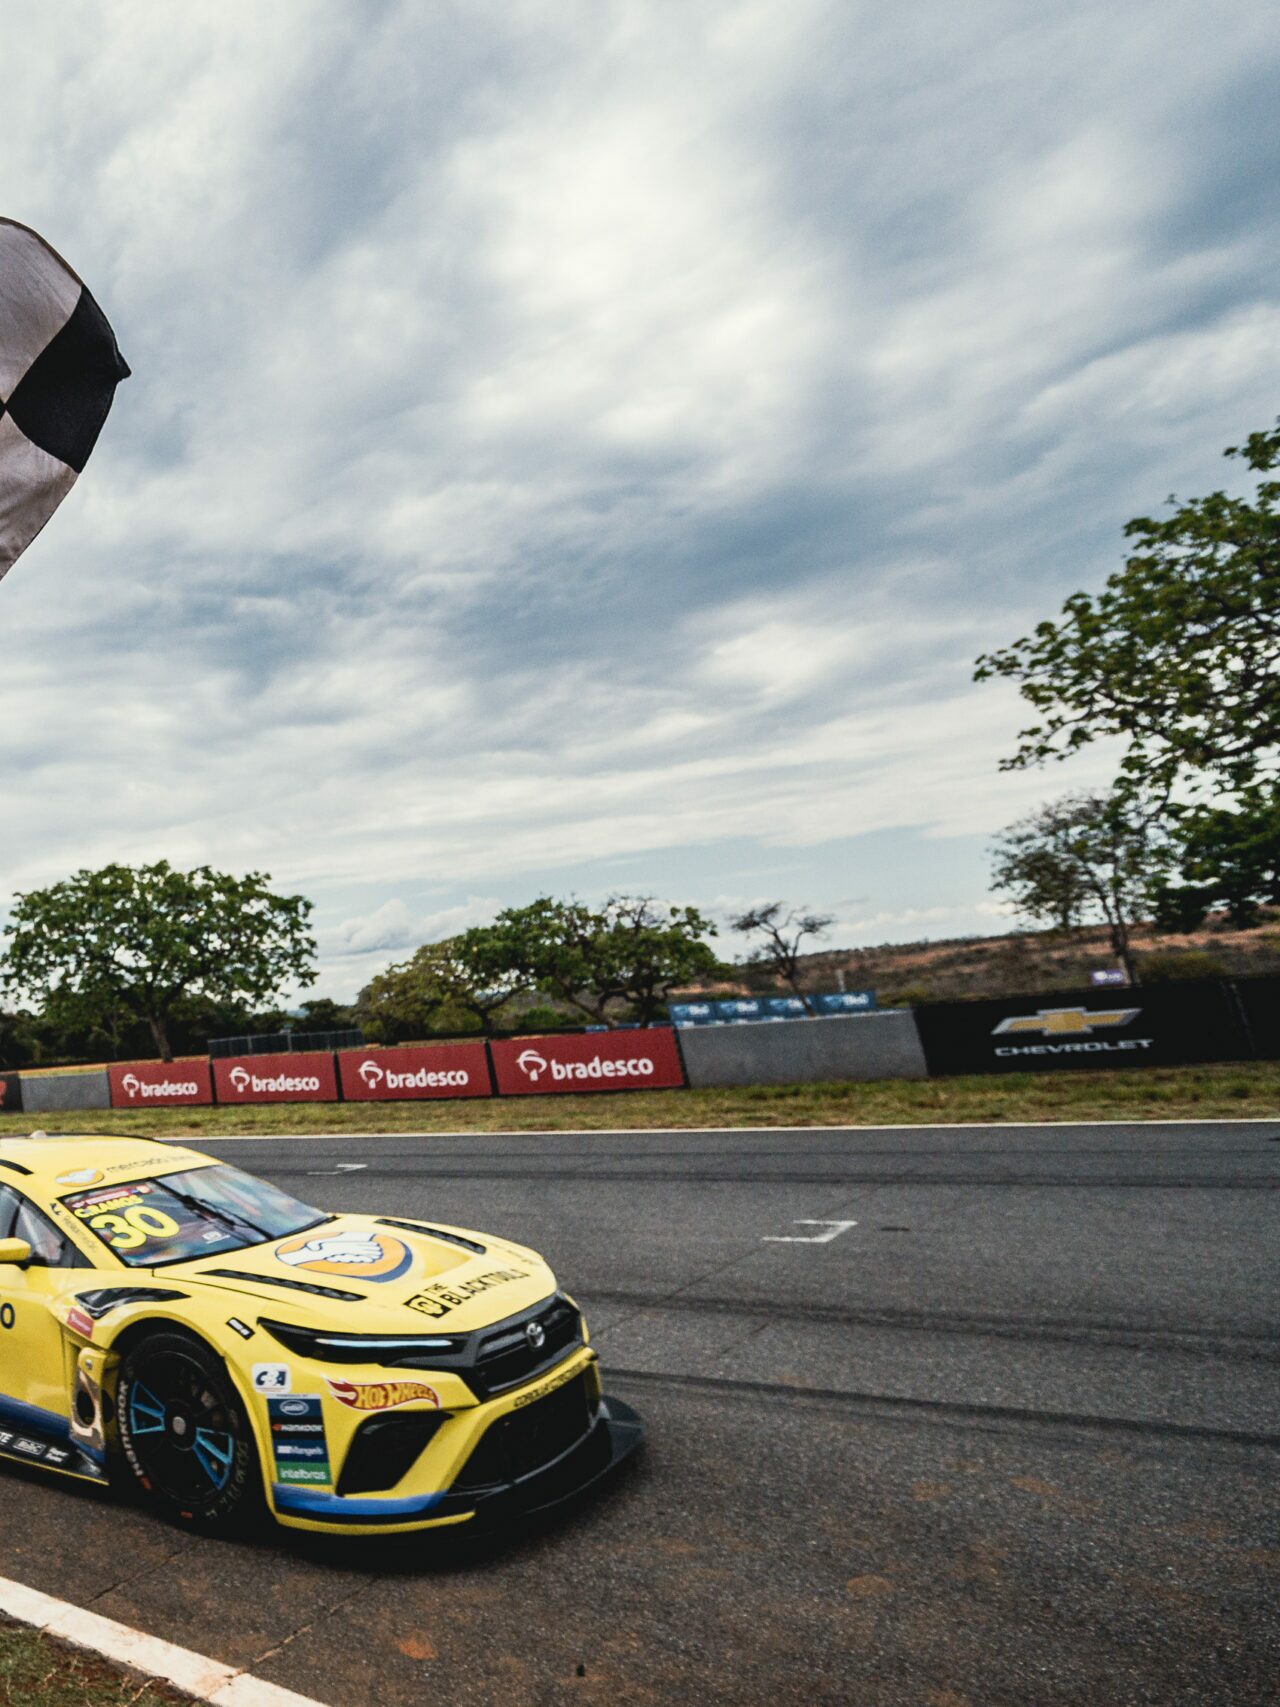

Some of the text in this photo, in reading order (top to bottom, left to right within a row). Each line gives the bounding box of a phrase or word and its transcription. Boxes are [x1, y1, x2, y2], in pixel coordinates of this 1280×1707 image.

[994, 1038, 1154, 1058] CHEVROLET
[385, 1066, 469, 1089] bradesco
[550, 1056, 654, 1079] bradesco
[140, 1078, 198, 1097] bradesco
[251, 1073, 320, 1092] bradesco
[90, 1206, 180, 1249] 30
[353, 1385, 387, 1409] HOT
